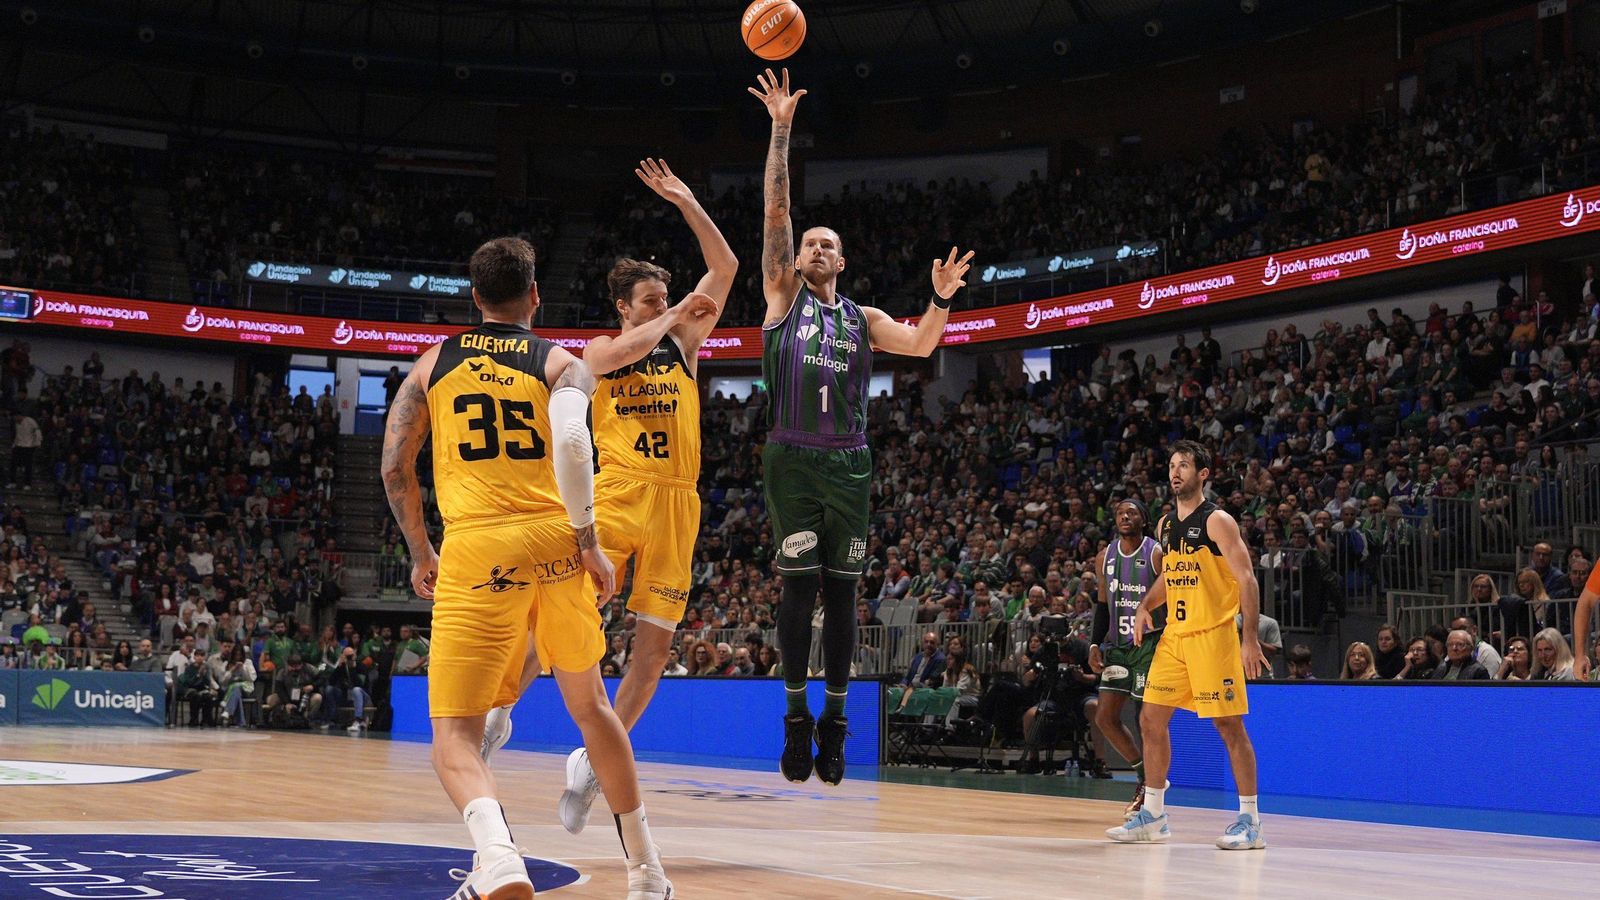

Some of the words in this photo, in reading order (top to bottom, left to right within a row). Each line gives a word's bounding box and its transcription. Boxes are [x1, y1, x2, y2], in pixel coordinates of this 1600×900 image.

[1586, 200, 1600, 214] DO
[1419, 231, 1447, 248] DOÑA
[1449, 217, 1519, 241] FRANCISQUITA
[1452, 240, 1484, 254] catering
[267, 263, 312, 275] Fundación
[1282, 259, 1308, 274] DOÑA
[1309, 247, 1370, 270] FRANCISQUITA
[267, 271, 299, 283] Unicaja
[1156, 283, 1179, 299] DOÑA
[1180, 274, 1235, 295] FRANCISQUITA
[46, 301, 76, 314] DOÑA
[79, 304, 149, 321] FRANCISQUITA
[206, 317, 236, 330] DOÑA
[238, 320, 304, 335] FRANCISQUITA
[355, 328, 384, 341] DOÑA
[460, 333, 529, 354] GUERRA
[818, 333, 857, 353] Unicaja
[803, 352, 848, 372] málaga
[611, 386, 625, 398] LA
[629, 383, 680, 397] LAGUNA
[819, 385, 828, 413] 1
[453, 393, 545, 461] 35
[634, 431, 669, 459] 42
[1172, 561, 1202, 573] AGUNA
[1119, 583, 1147, 594] Unicaja
[1175, 600, 1186, 621] 6
[74, 689, 155, 714] Unicaja
